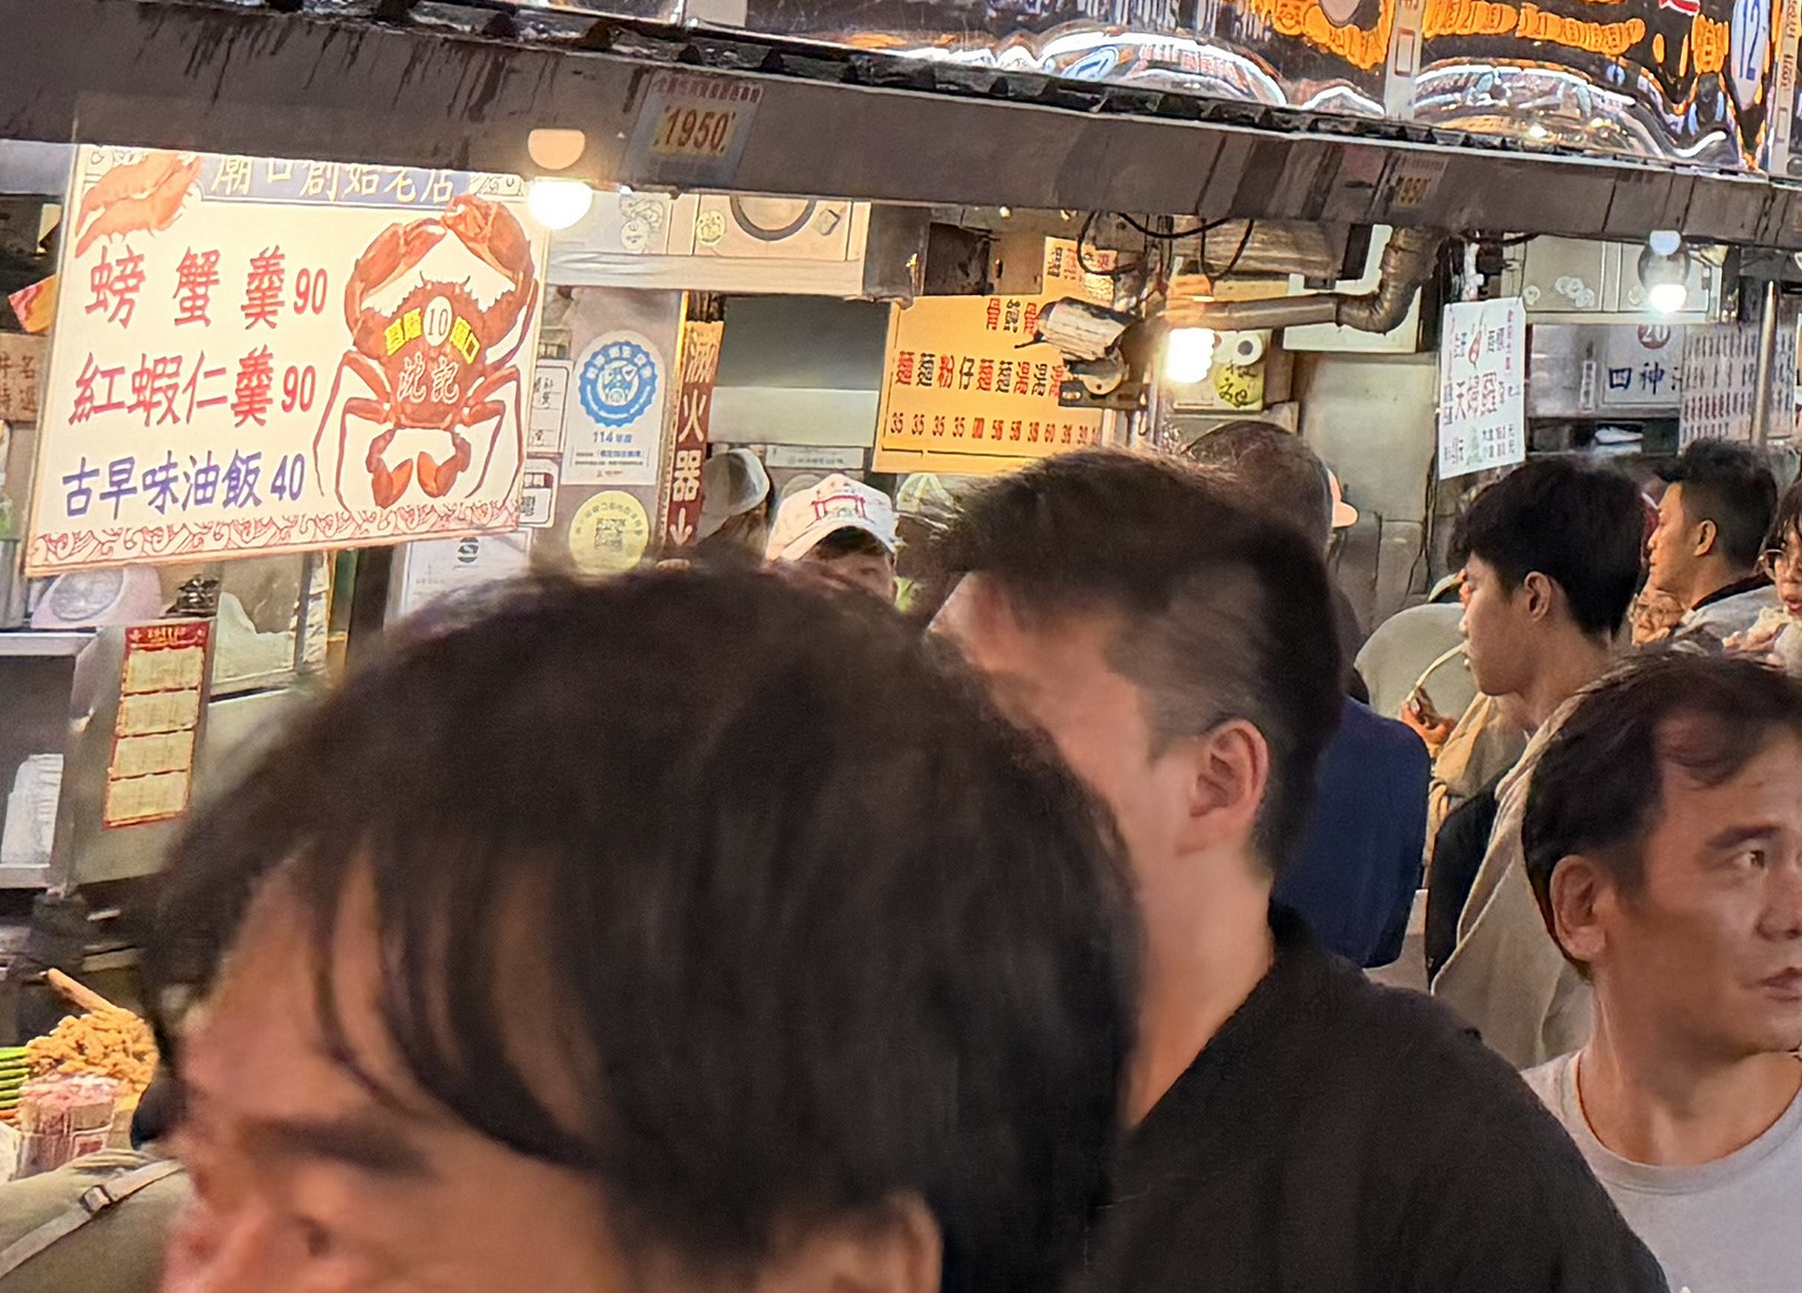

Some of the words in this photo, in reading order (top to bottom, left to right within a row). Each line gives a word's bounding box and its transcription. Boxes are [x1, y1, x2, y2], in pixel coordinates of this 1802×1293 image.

[211, 157, 457, 205] 廟口創始老店
[293, 267, 329, 316] 90
[426, 307, 449, 339] 10
[281, 364, 317, 414] 90
[671, 324, 719, 504] 滅火器
[62, 448, 266, 521] 古早味油飯
[269, 452, 305, 503] 40
